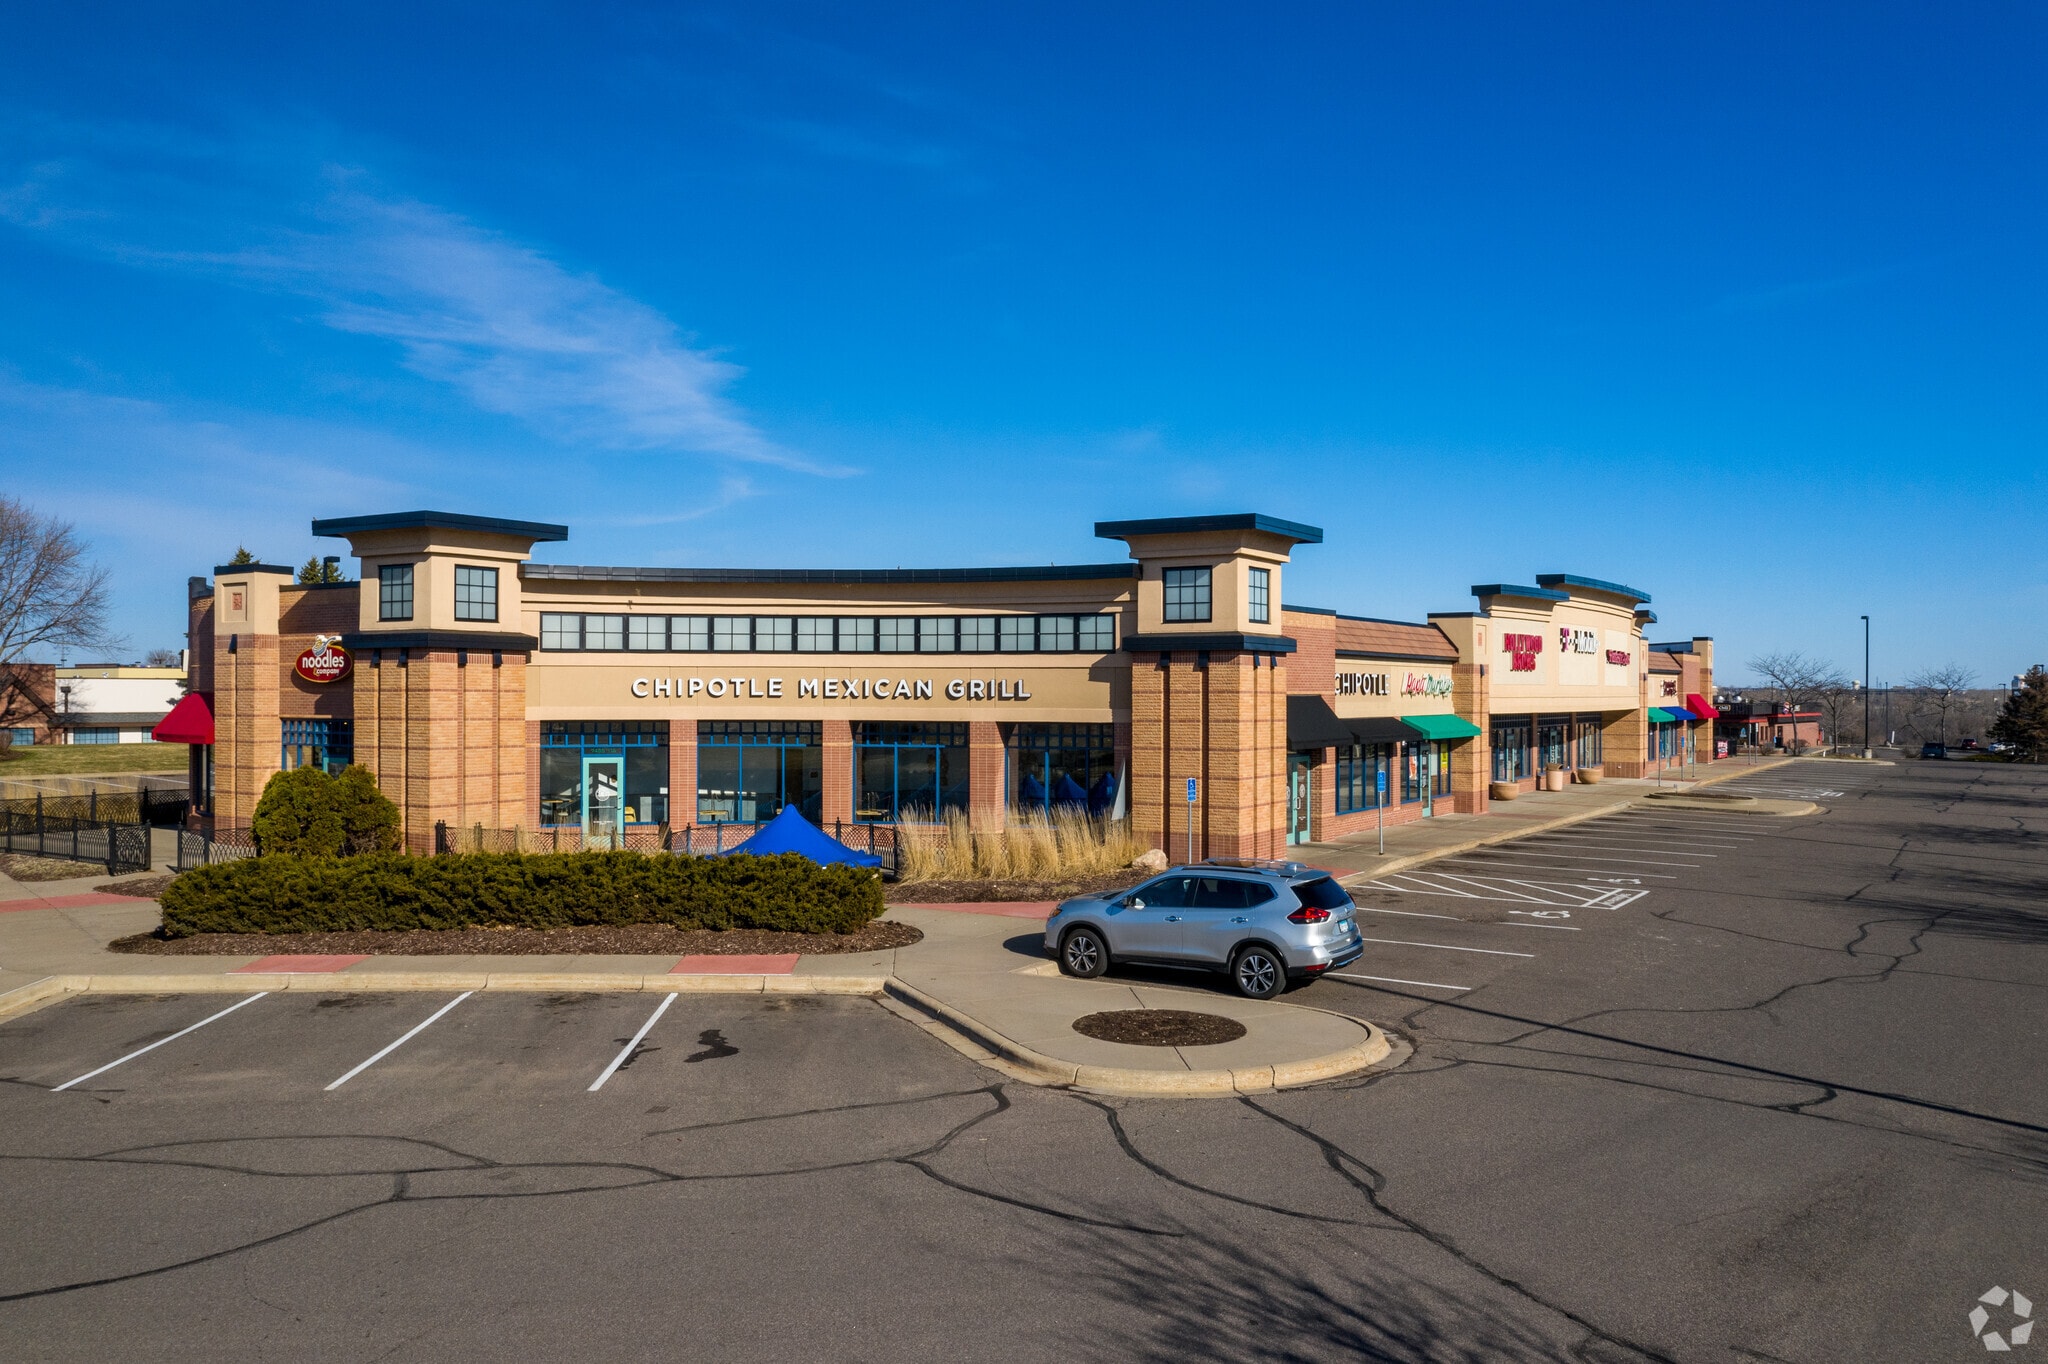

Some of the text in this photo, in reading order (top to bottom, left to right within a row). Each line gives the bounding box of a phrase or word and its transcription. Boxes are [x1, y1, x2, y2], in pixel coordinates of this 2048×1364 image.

[302, 649, 344, 668] noodles
[631, 677, 1031, 700] CHIPOTLE MEXICAN GRILL
